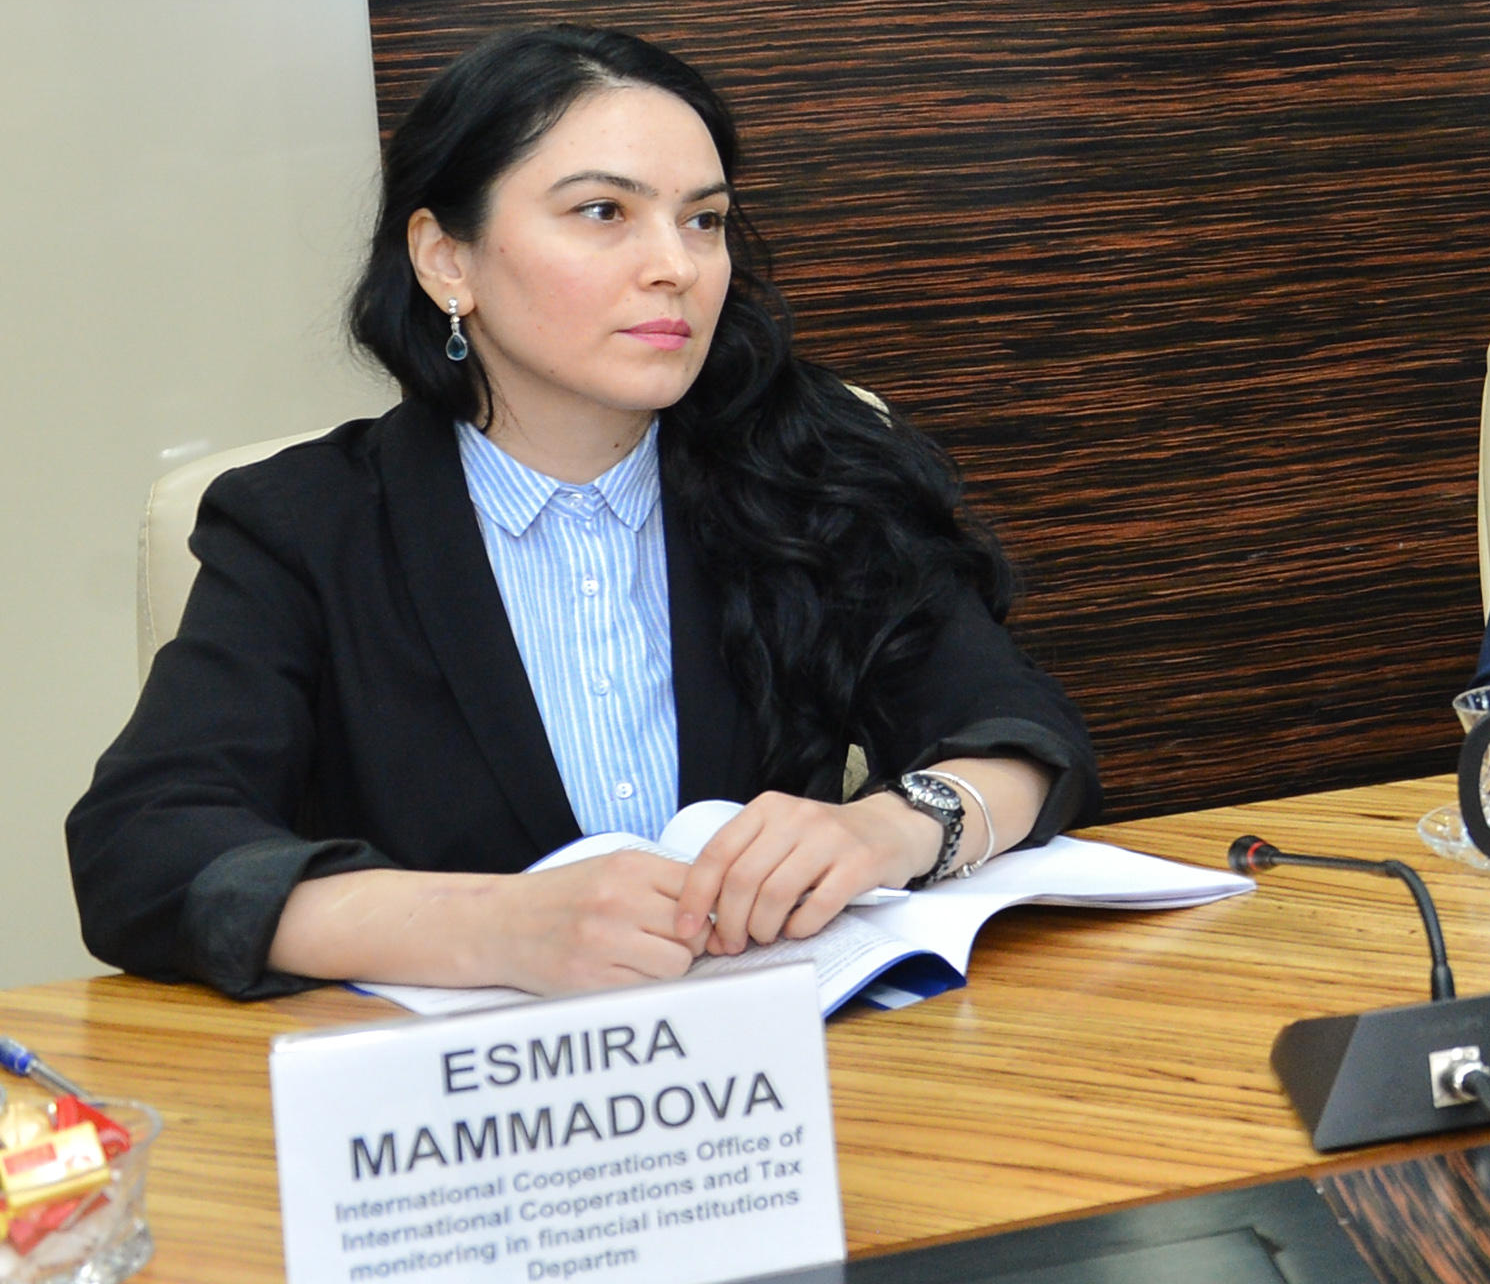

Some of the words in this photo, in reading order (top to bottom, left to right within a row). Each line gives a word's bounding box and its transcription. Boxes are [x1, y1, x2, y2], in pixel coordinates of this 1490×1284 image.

[442, 1018, 686, 1095] ESMIRA
[336, 1175, 502, 1221] International
[513, 1147, 687, 1193] Cooperations
[696, 1132, 771, 1162] Office
[780, 1125, 804, 1149] of
[350, 1071, 784, 1181] MAMMADOVA
[342, 1205, 511, 1253] International
[519, 1175, 694, 1223] Cooperations
[703, 1163, 750, 1191] and
[759, 1158, 802, 1181] Tax
[349, 1241, 497, 1283] monitoring
[506, 1232, 530, 1256] in
[538, 1218, 649, 1250] financial
[657, 1187, 801, 1228] institutions
[527, 1245, 638, 1283] Departm
